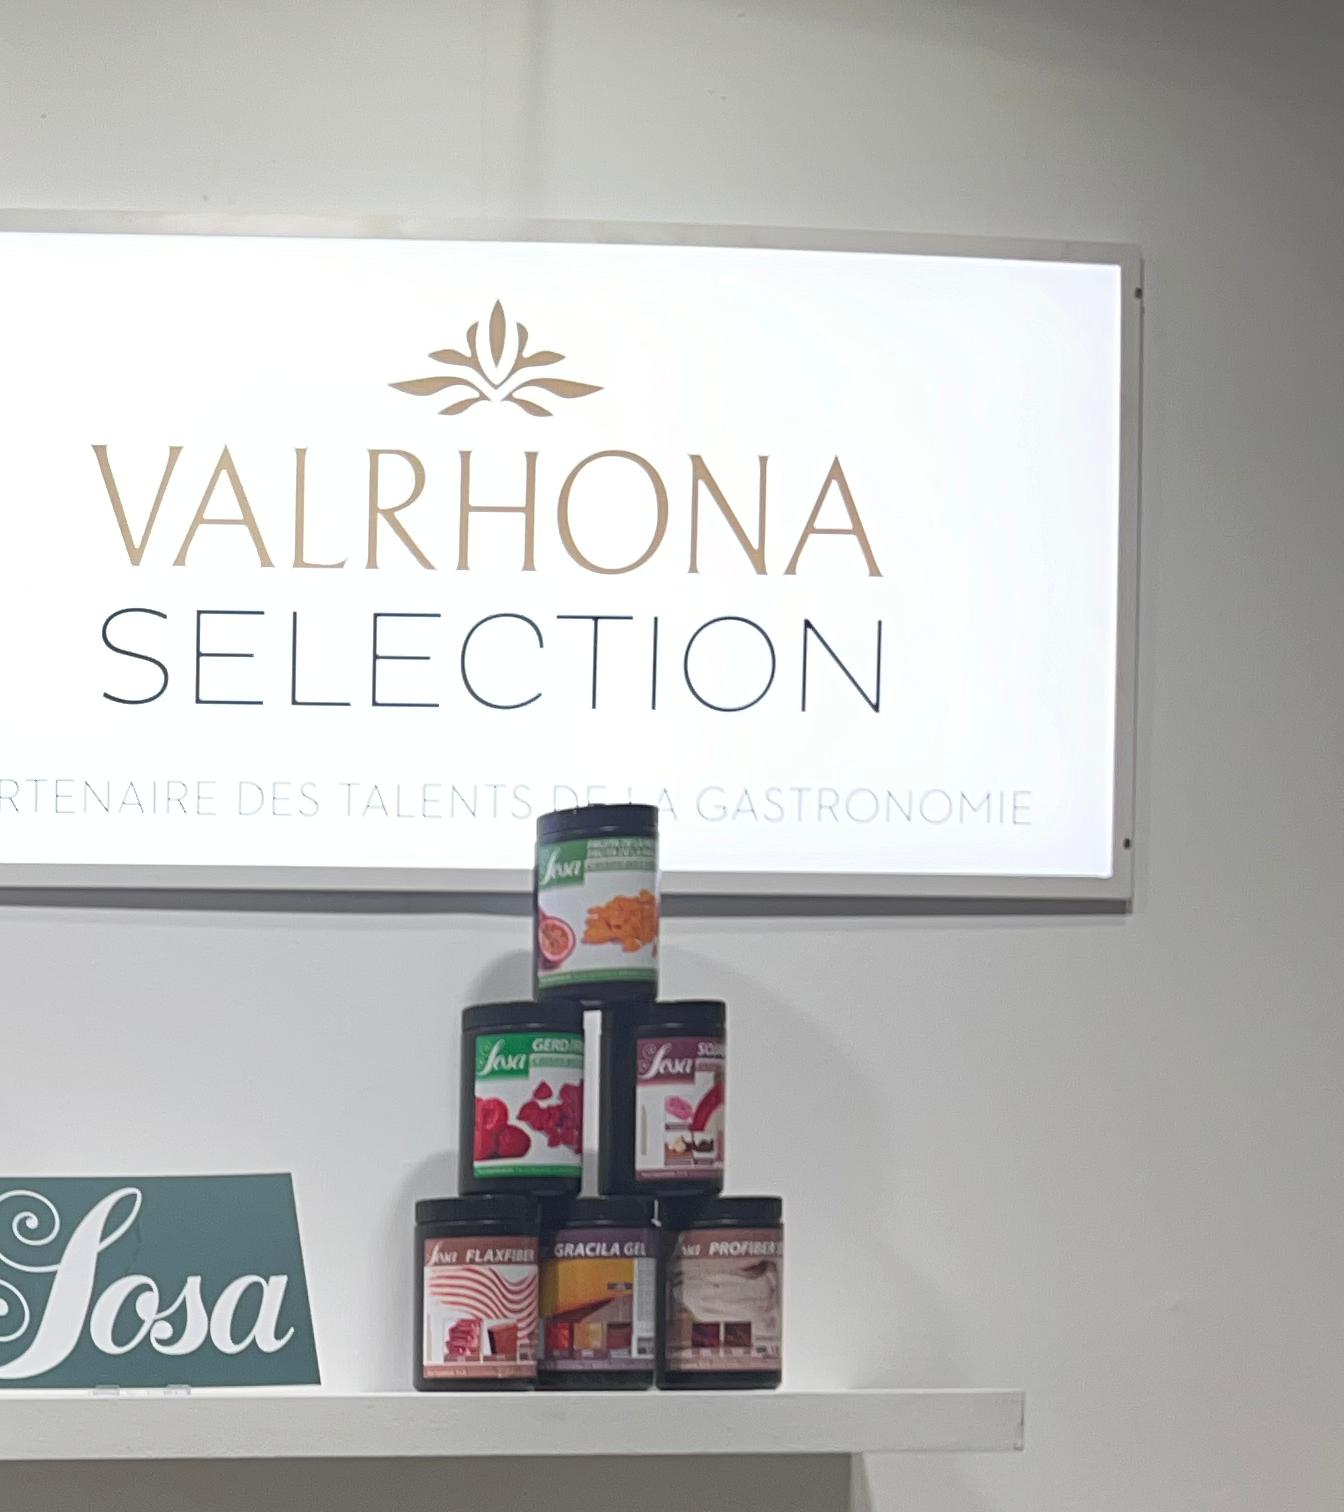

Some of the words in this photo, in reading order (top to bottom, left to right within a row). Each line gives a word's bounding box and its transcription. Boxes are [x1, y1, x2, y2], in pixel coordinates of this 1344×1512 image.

[90, 442, 885, 579] VALRHONA
[101, 606, 886, 716] SELECTION
[235, 780, 320, 819] DES
[339, 783, 534, 824] TALENTS
[696, 784, 1036, 827] GASTRONOMIE
[465, 1247, 536, 1265] FLAXFIBER
[554, 1242, 620, 1259] GRACILA
[624, 1242, 647, 1258] GEL
